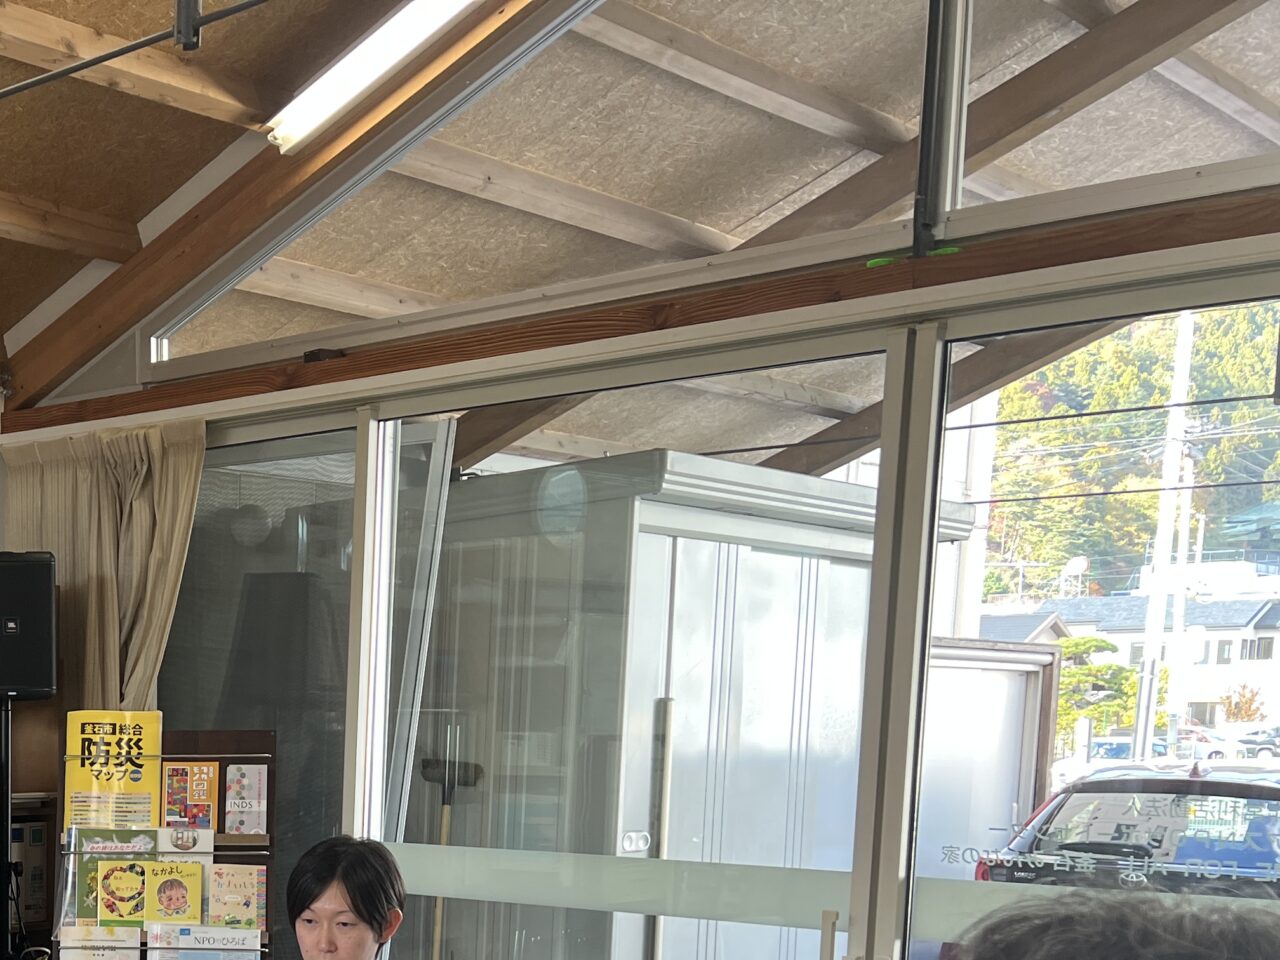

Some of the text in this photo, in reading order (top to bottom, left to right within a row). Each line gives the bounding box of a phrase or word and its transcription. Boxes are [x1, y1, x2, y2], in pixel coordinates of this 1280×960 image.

[84, 723, 143, 736] 釜石市 総合
[81, 737, 145, 769] 防災
[90, 769, 129, 781] マップ
[151, 866, 182, 877] なかよし
